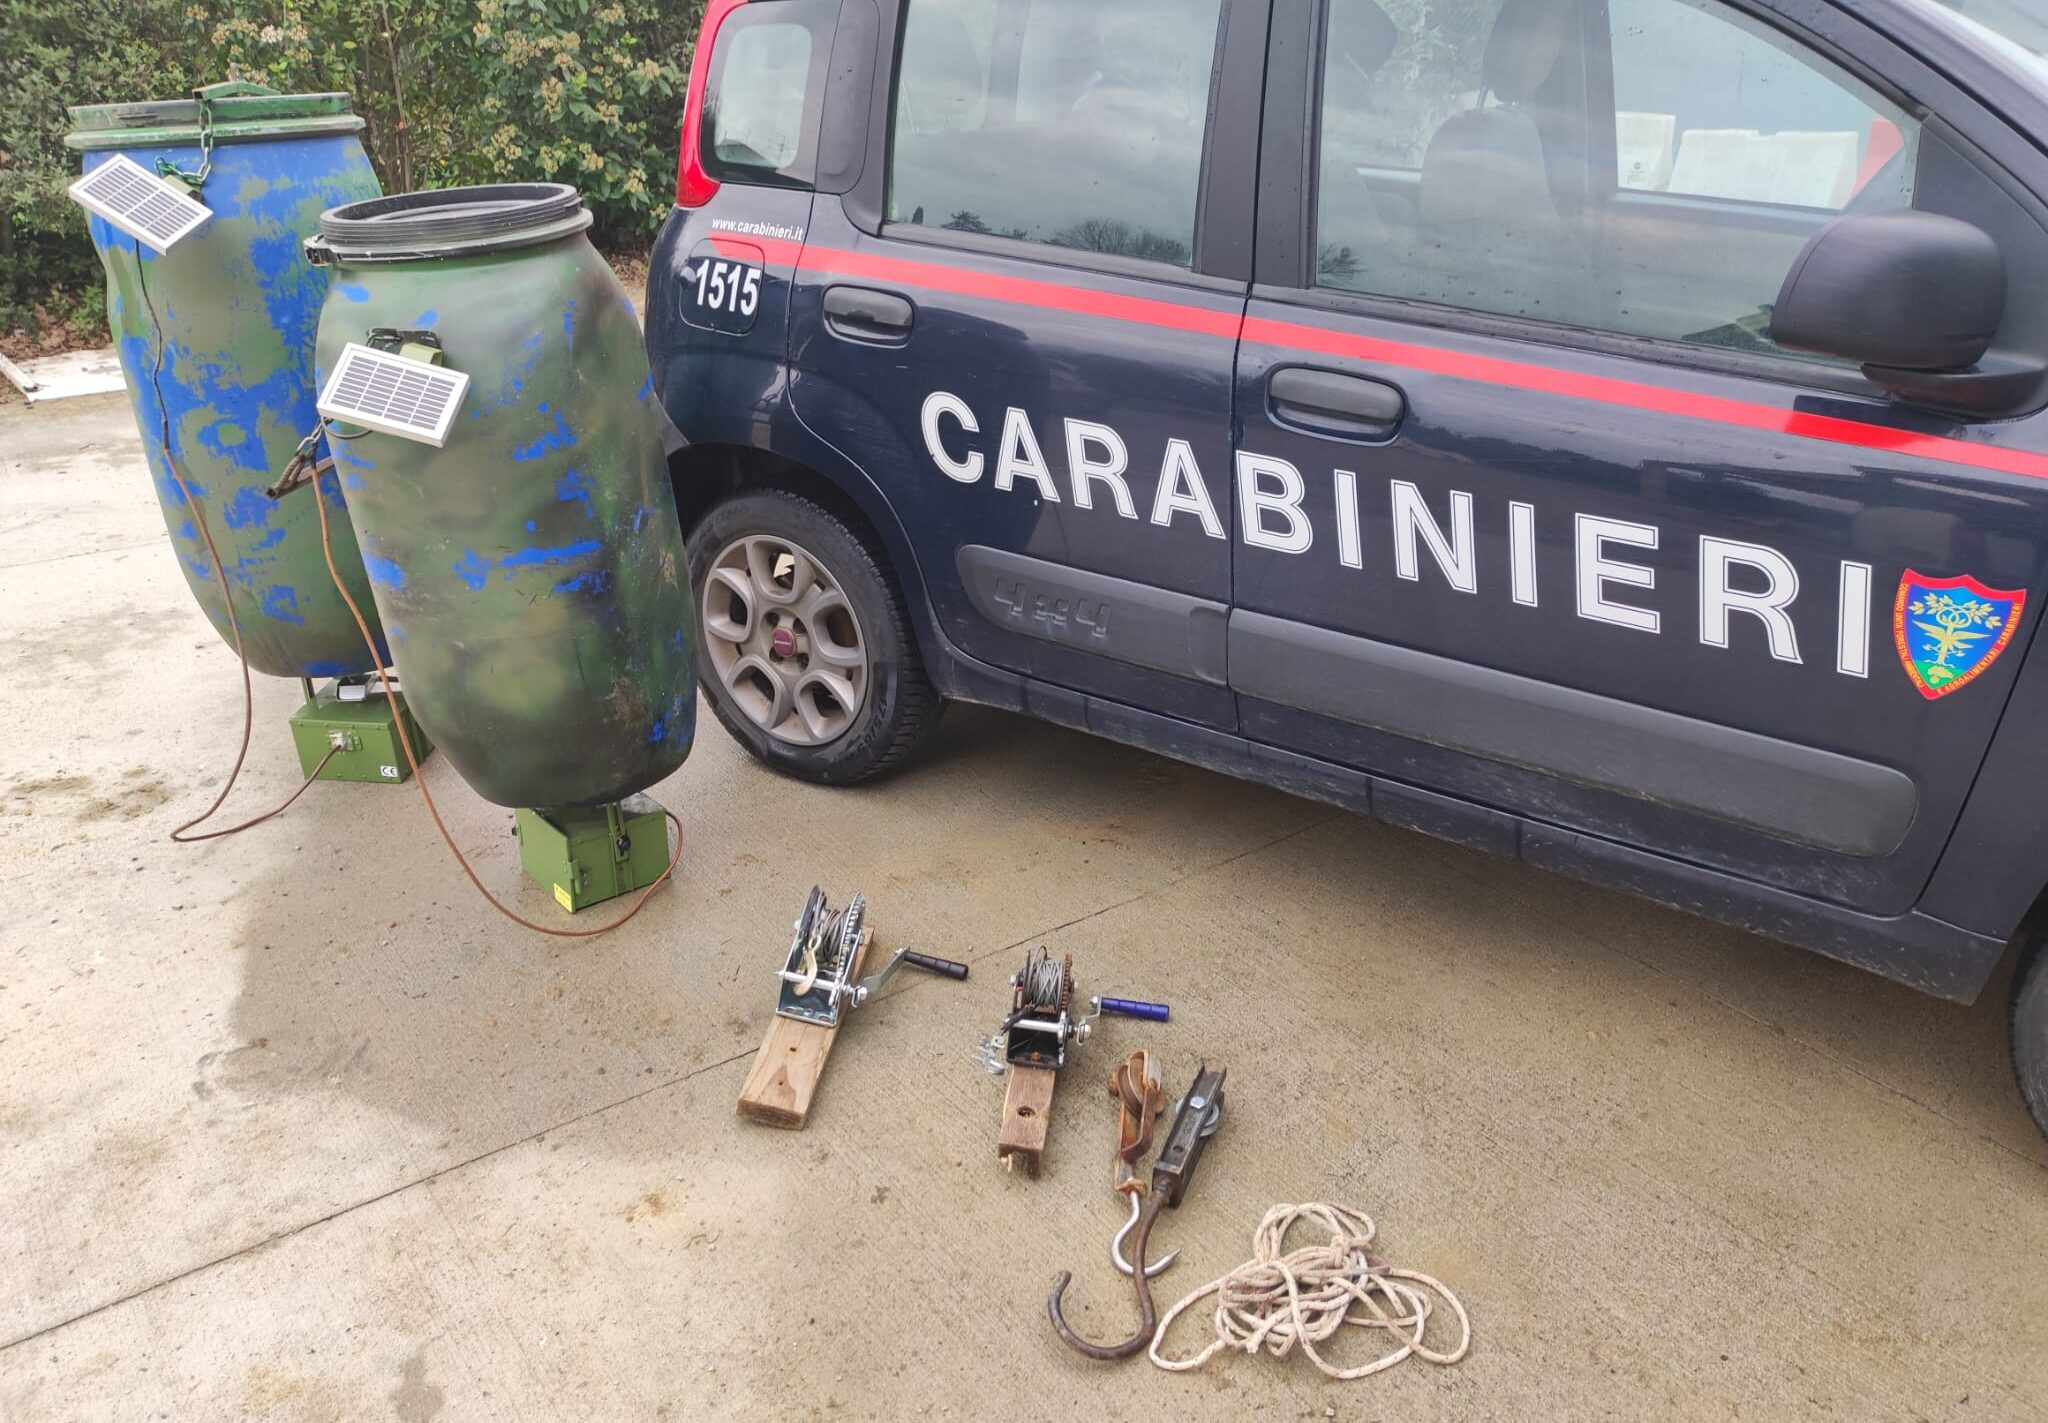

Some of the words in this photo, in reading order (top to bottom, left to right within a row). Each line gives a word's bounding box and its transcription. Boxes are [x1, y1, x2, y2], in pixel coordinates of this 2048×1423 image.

[711, 217, 803, 241] www.carabinieri.it
[696, 259, 761, 316] 1515
[921, 391, 1873, 679] CARABINIERI
